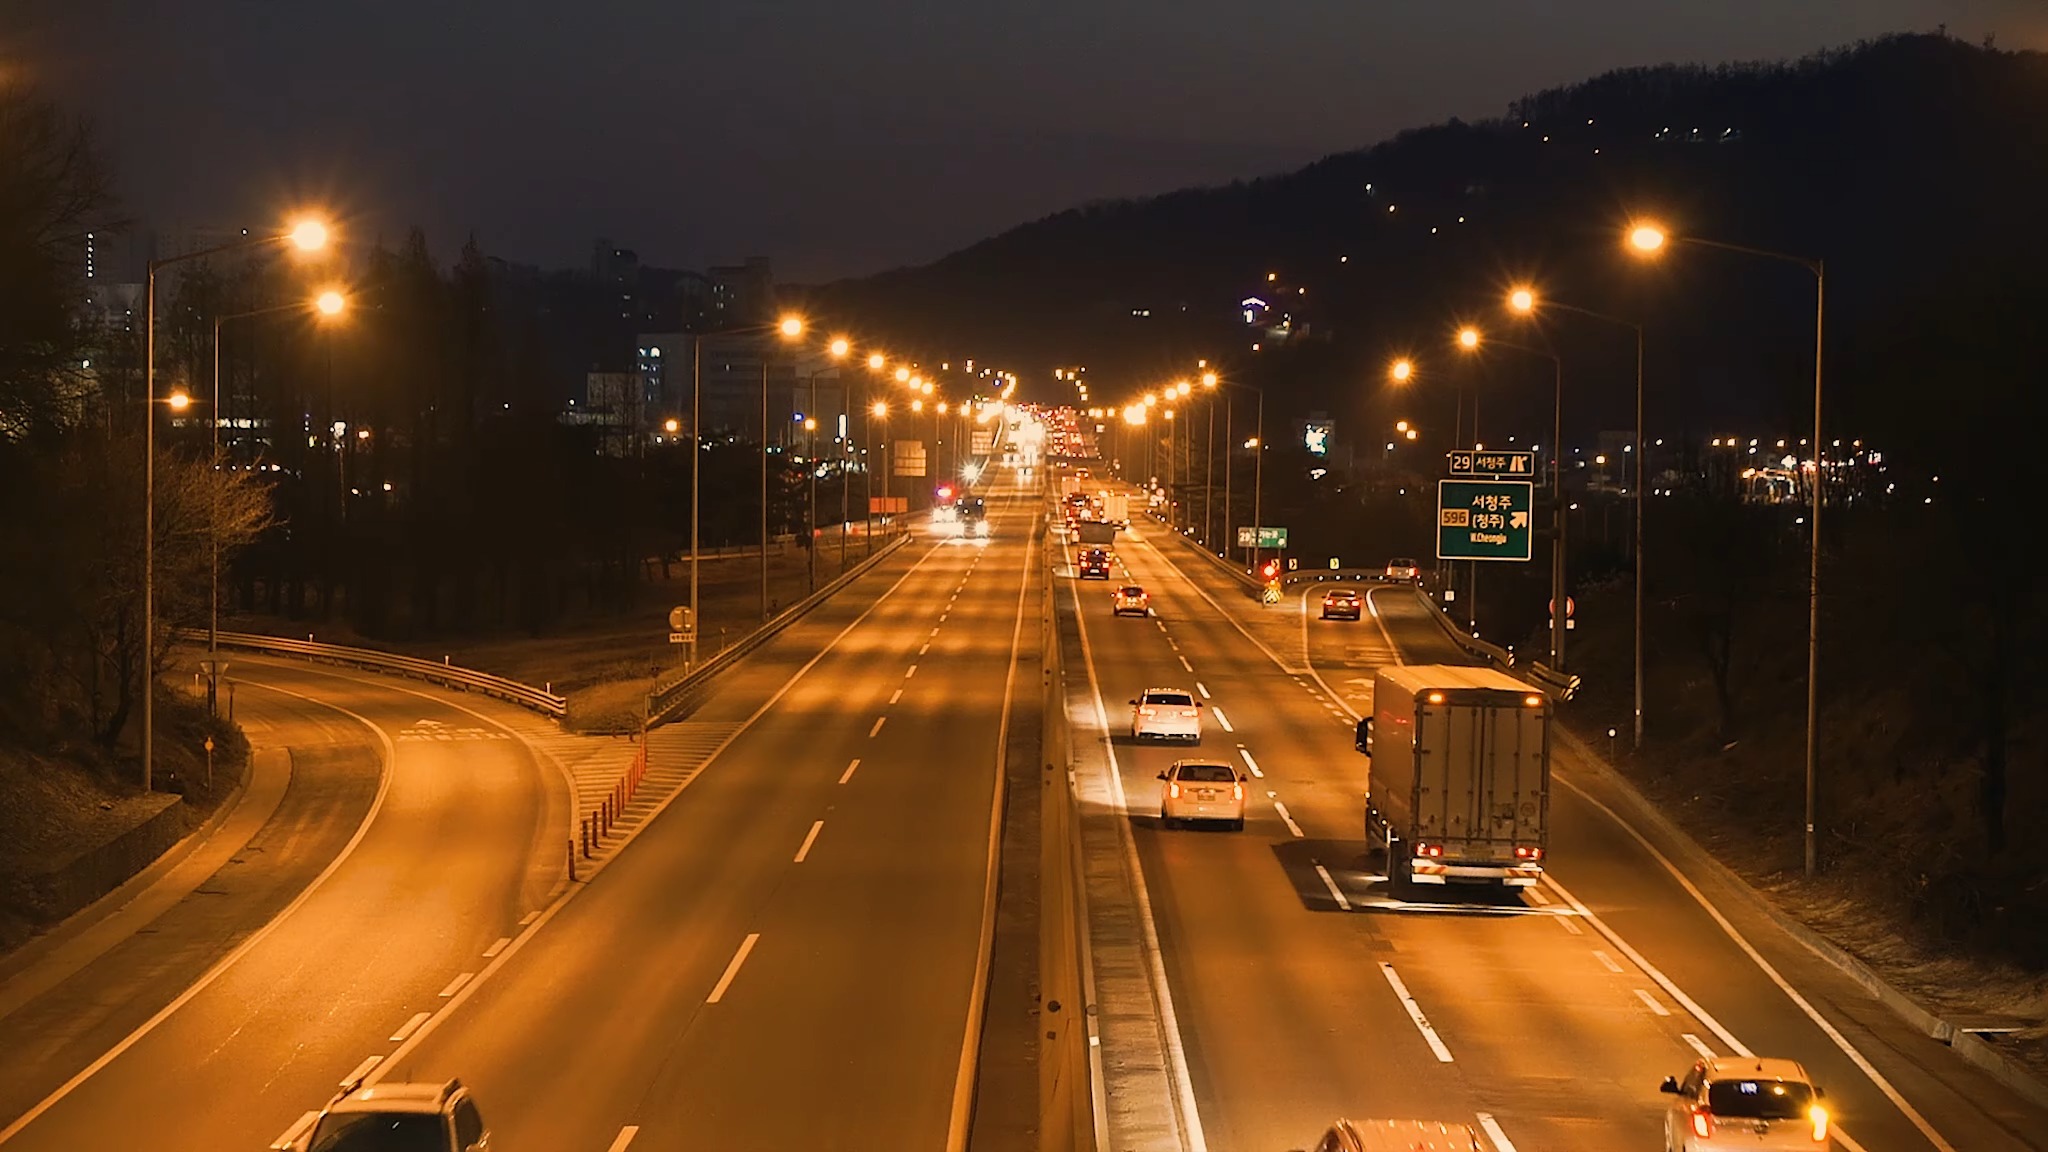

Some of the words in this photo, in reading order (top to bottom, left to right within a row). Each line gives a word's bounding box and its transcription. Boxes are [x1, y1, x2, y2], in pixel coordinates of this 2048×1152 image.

[1453, 456, 1470, 469] 29
[1476, 456, 1506, 469] 서청주
[1472, 495, 1512, 511] 서청주
[1444, 512, 1466, 524] 596
[1473, 514, 1504, 529] (청주)
